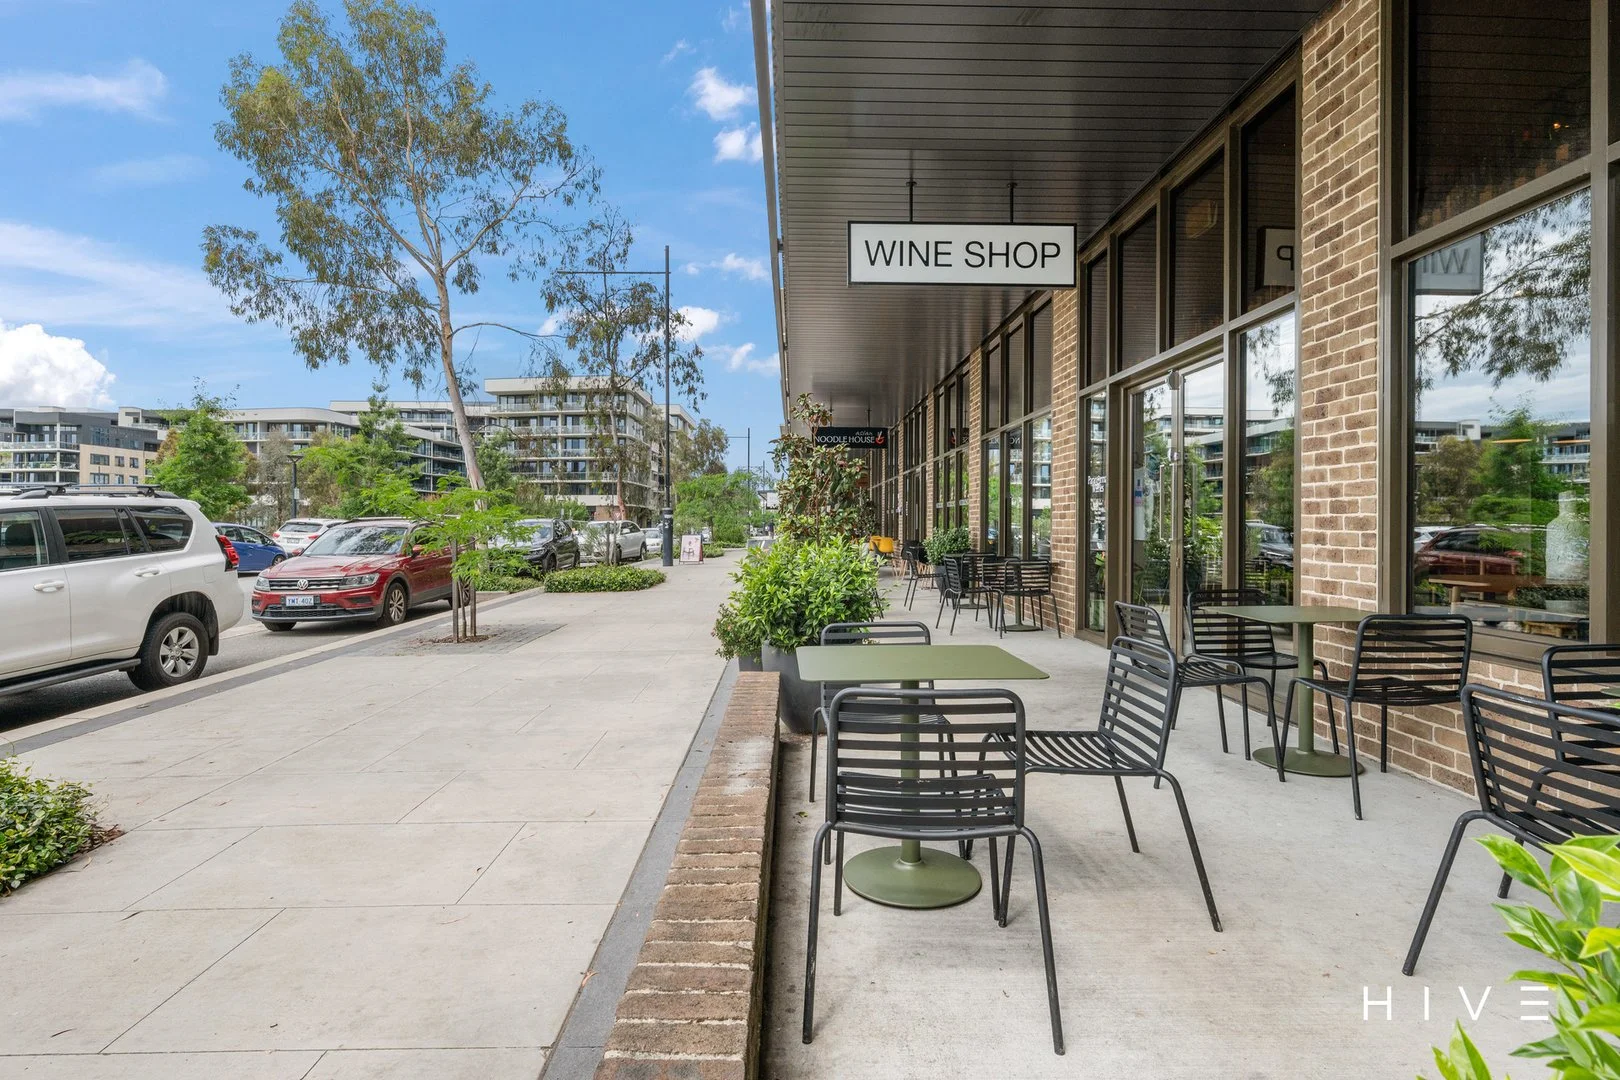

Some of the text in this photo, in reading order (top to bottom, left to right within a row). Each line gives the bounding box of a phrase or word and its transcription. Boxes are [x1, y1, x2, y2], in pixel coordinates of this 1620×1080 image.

[865, 240, 1061, 268] WINE SHOP
[815, 435, 875, 444] NOODLE HOUSE
